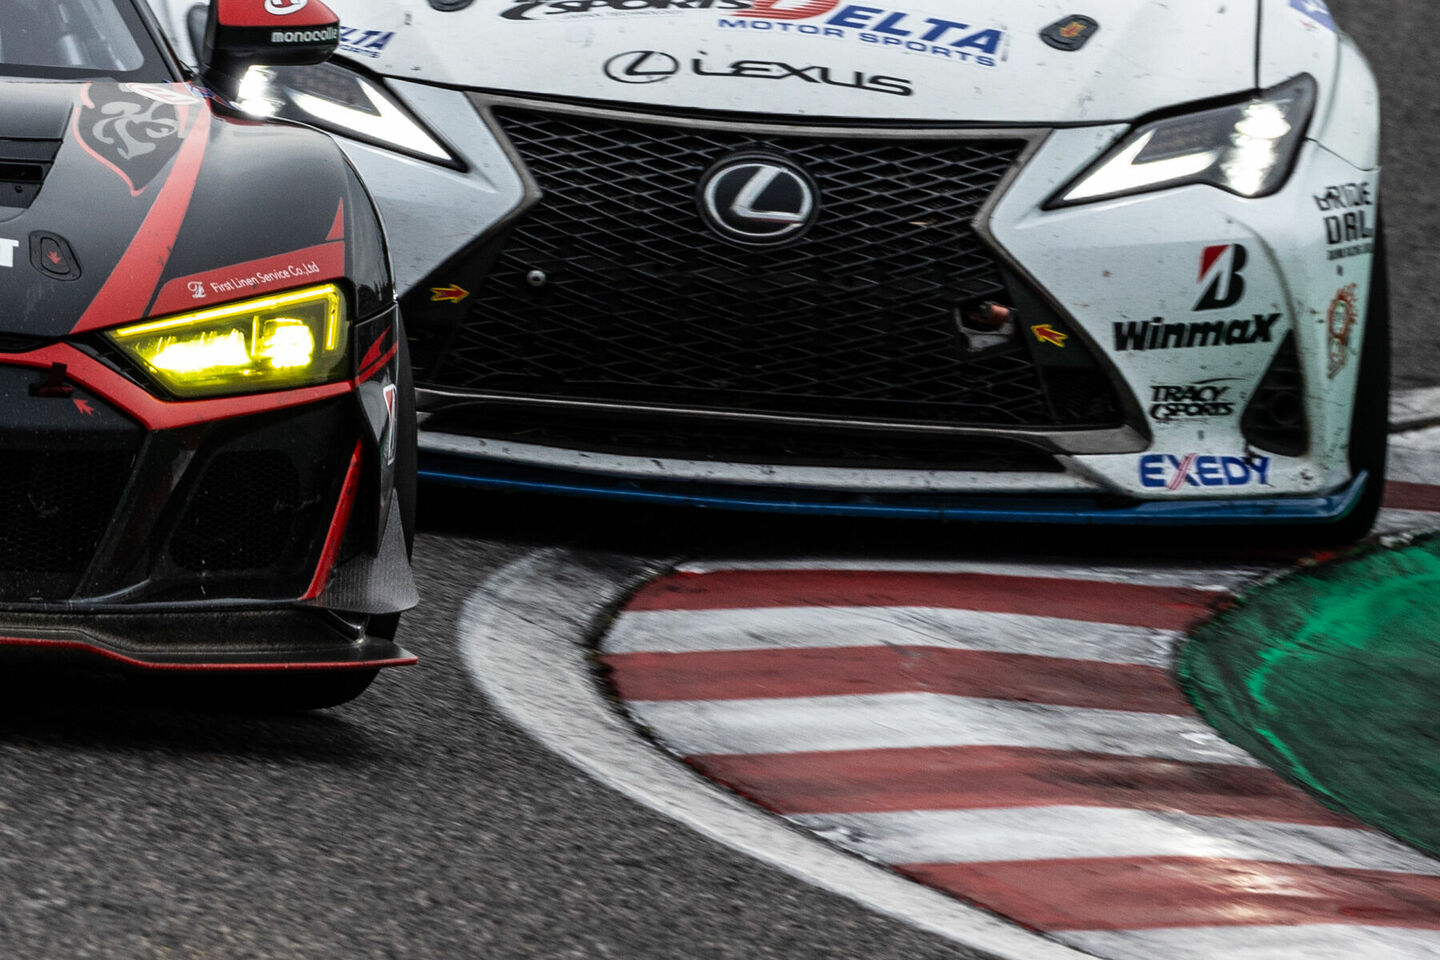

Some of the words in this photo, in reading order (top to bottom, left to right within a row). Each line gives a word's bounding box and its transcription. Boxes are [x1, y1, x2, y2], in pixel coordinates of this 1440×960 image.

[271, 27, 337, 43] monocolle
[717, 19, 846, 39] MOTOR
[858, 32, 996, 68] SPORTS
[691, 56, 915, 97] LEXUS
[210, 280, 233, 294] First
[235, 275, 260, 289] Linen
[259, 269, 290, 284] Service
[1150, 385, 1231, 402] TRACY
[1140, 453, 1271, 491] EXEDY
